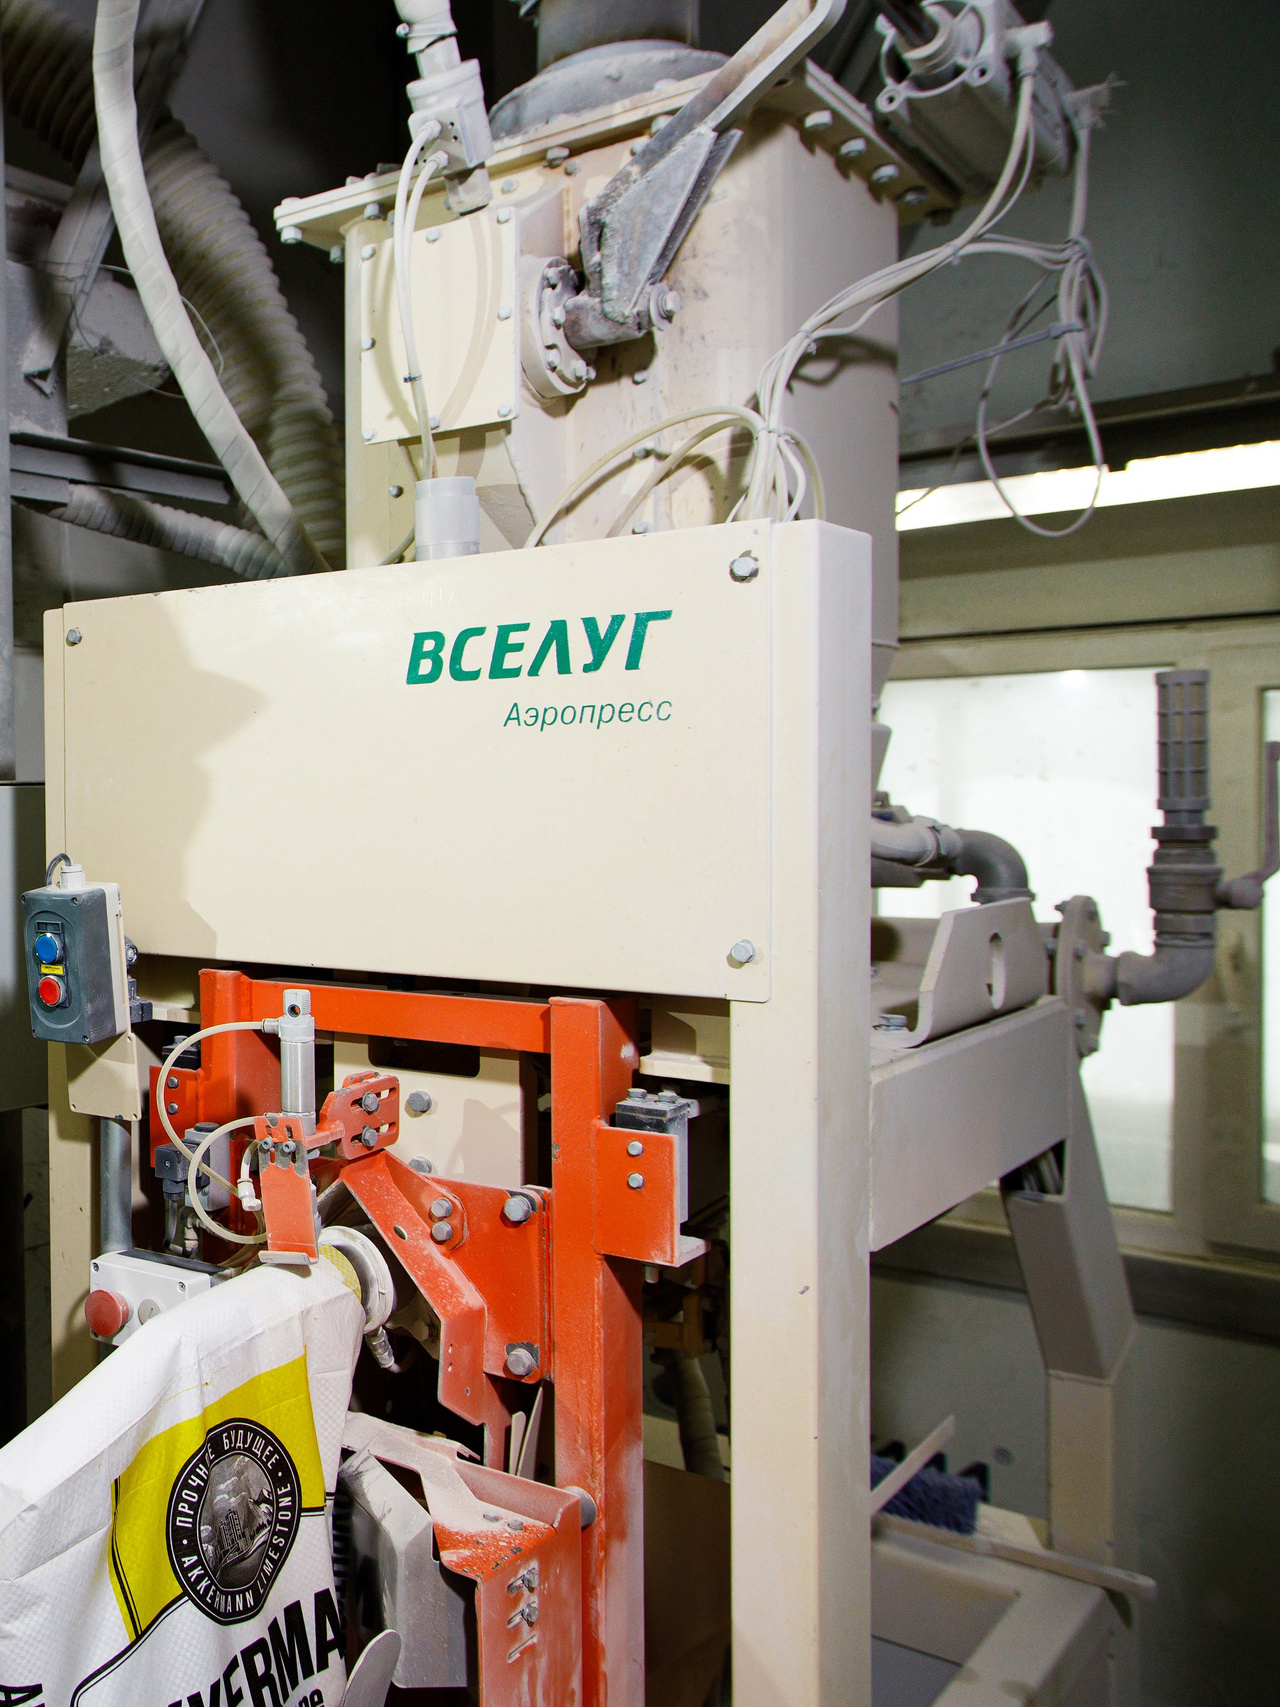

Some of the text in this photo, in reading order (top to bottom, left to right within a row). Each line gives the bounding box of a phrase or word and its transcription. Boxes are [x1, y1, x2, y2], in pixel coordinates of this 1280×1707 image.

[405, 609, 673, 685] ВСЕЛУГ
[503, 700, 673, 732] Аэропресс
[222, 1429, 280, 1470] БУДУЩЕЕ
[182, 1483, 292, 1613] AKKERMANN LIMESTONE
